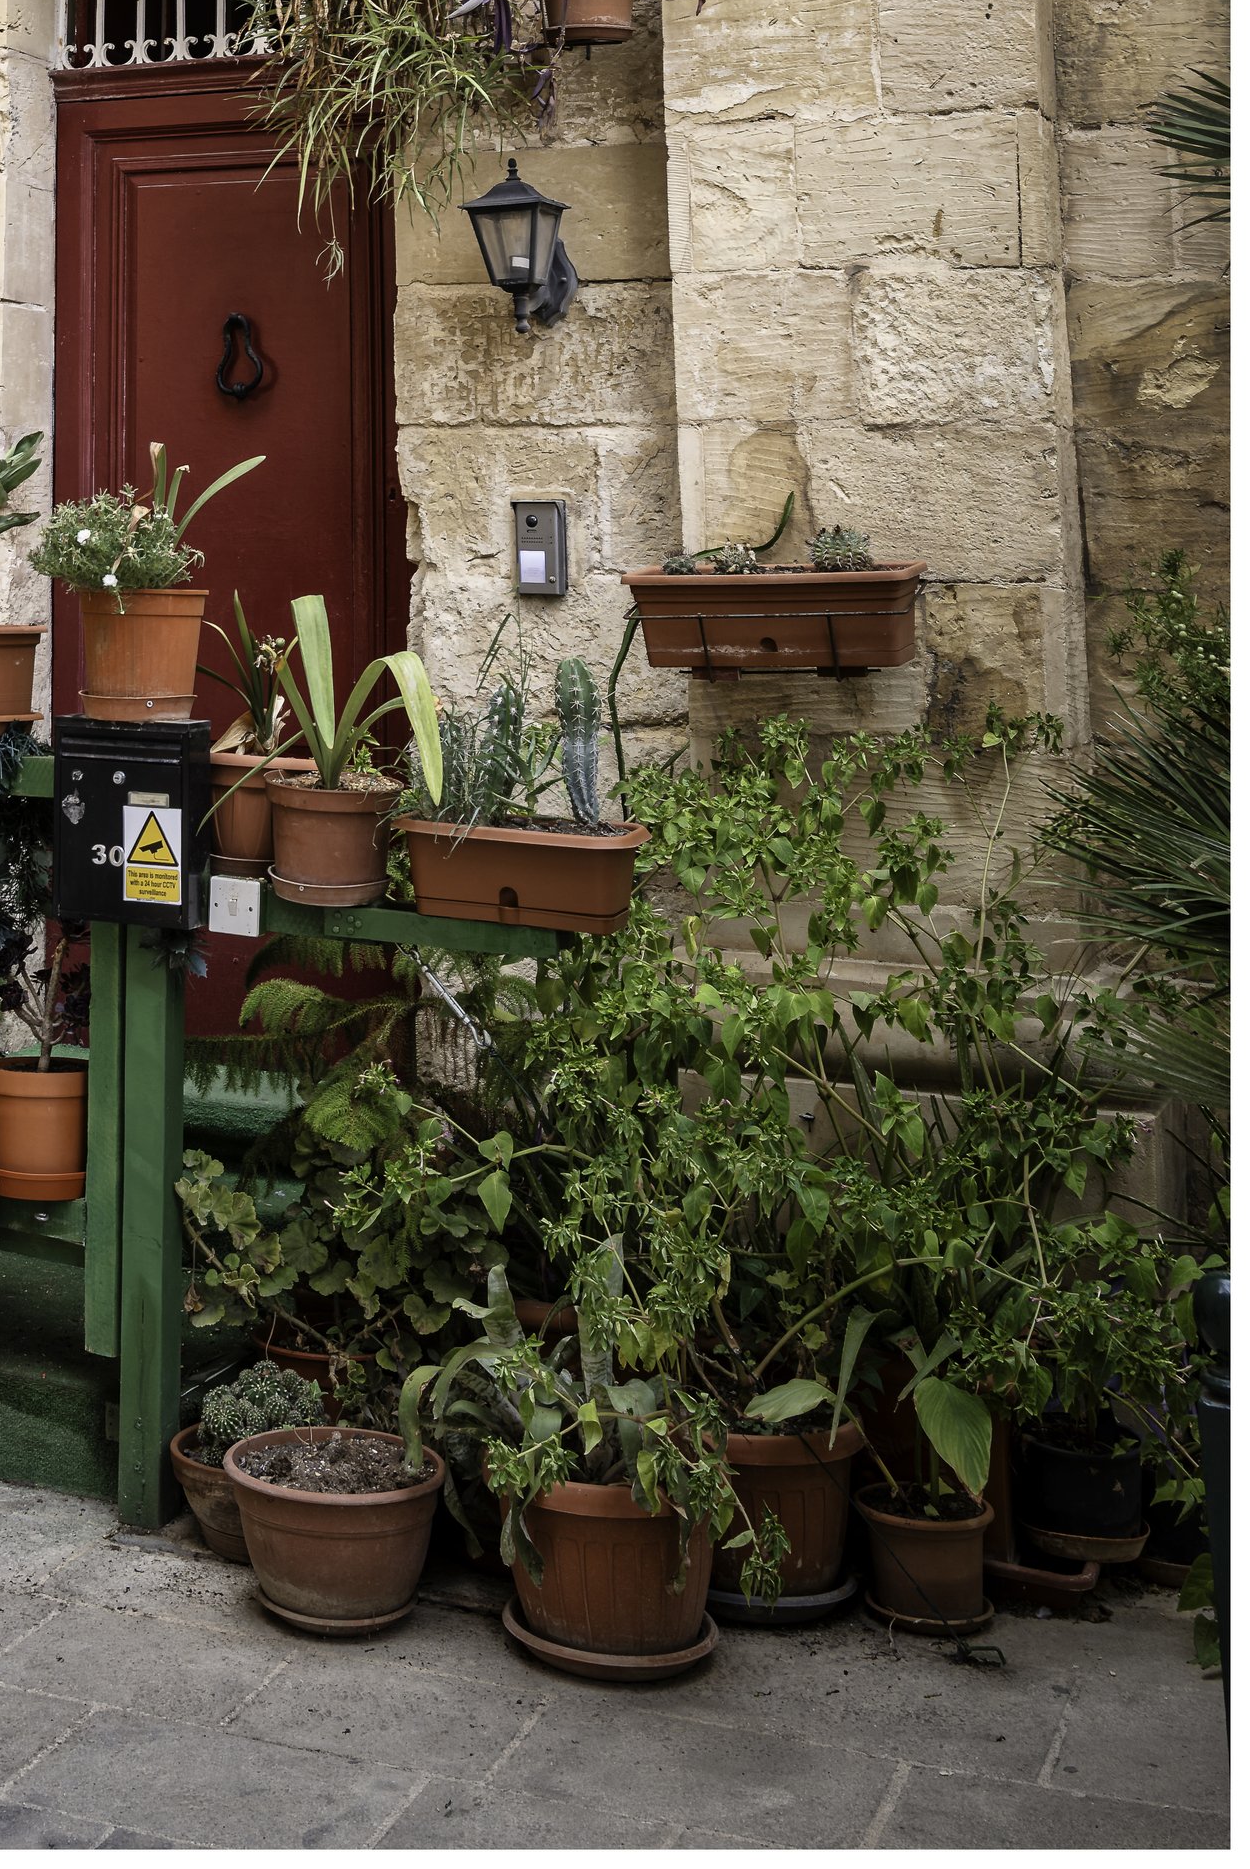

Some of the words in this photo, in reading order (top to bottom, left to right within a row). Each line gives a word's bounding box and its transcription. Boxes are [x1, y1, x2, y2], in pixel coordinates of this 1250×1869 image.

[91, 844, 125, 867] 30
[128, 870, 138, 878] This
[162, 881, 176, 889] CCTV
